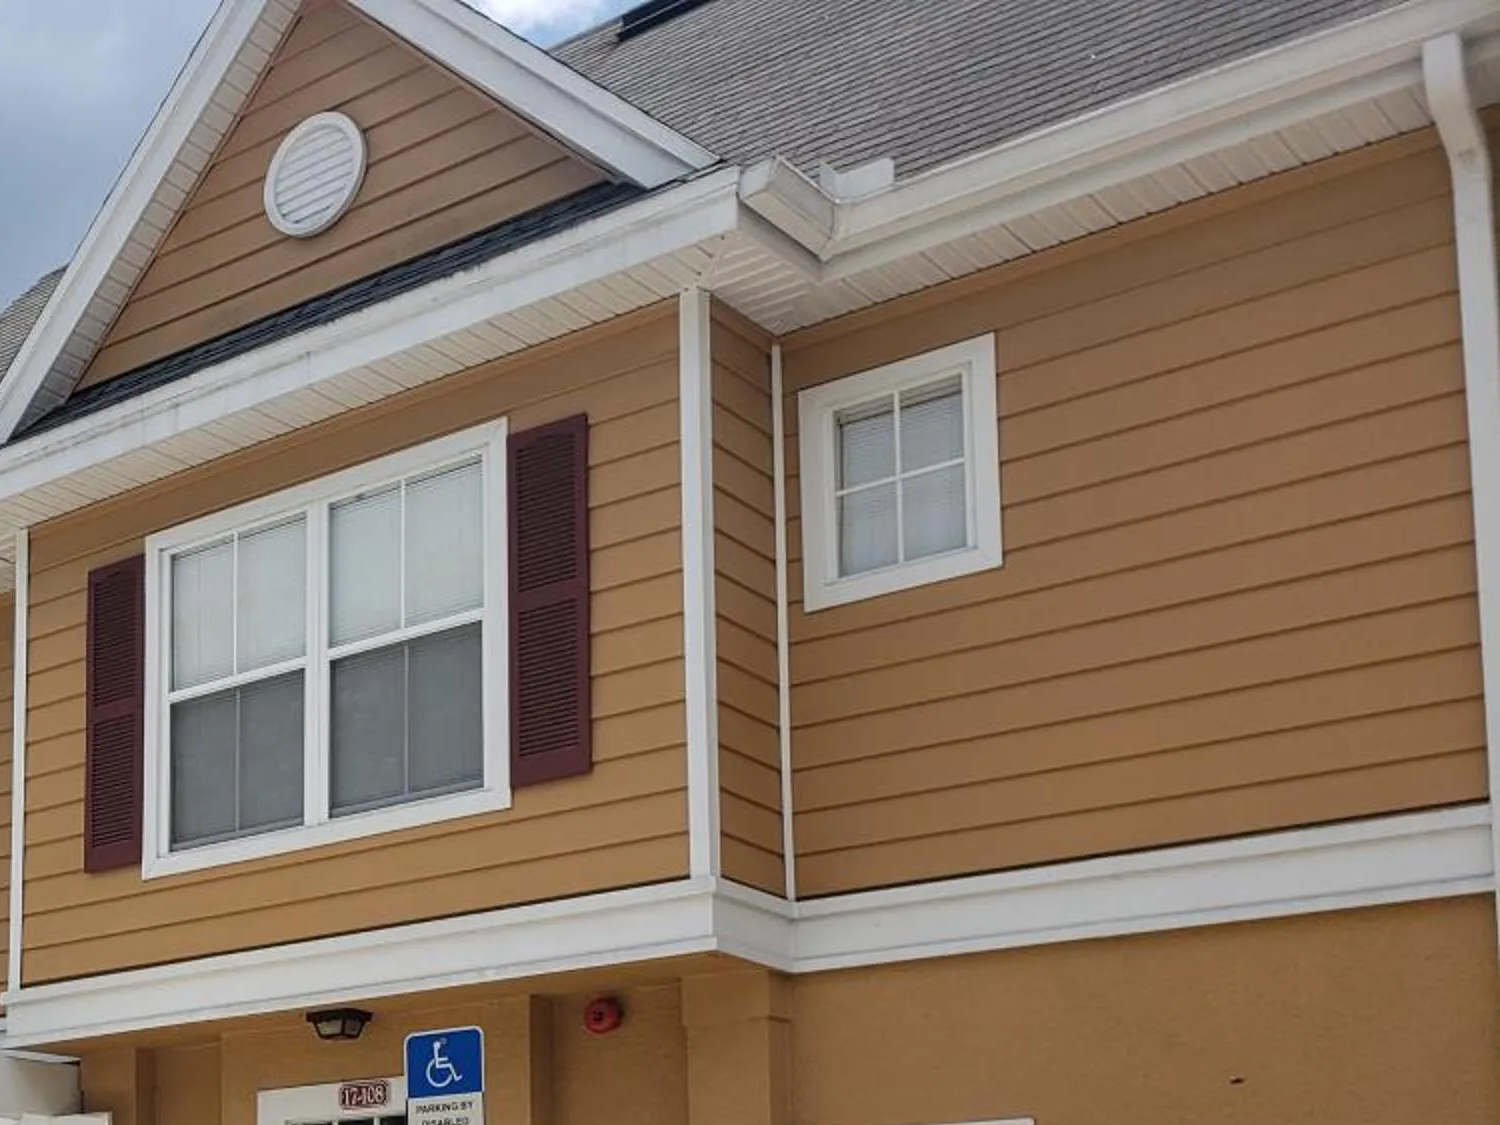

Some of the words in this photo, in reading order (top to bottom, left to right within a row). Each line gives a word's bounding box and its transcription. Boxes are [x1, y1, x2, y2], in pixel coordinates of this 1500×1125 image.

[344, 1085, 385, 1105] 17-108
[415, 1102, 458, 1115] PARKING
[461, 1101, 474, 1111] BY
